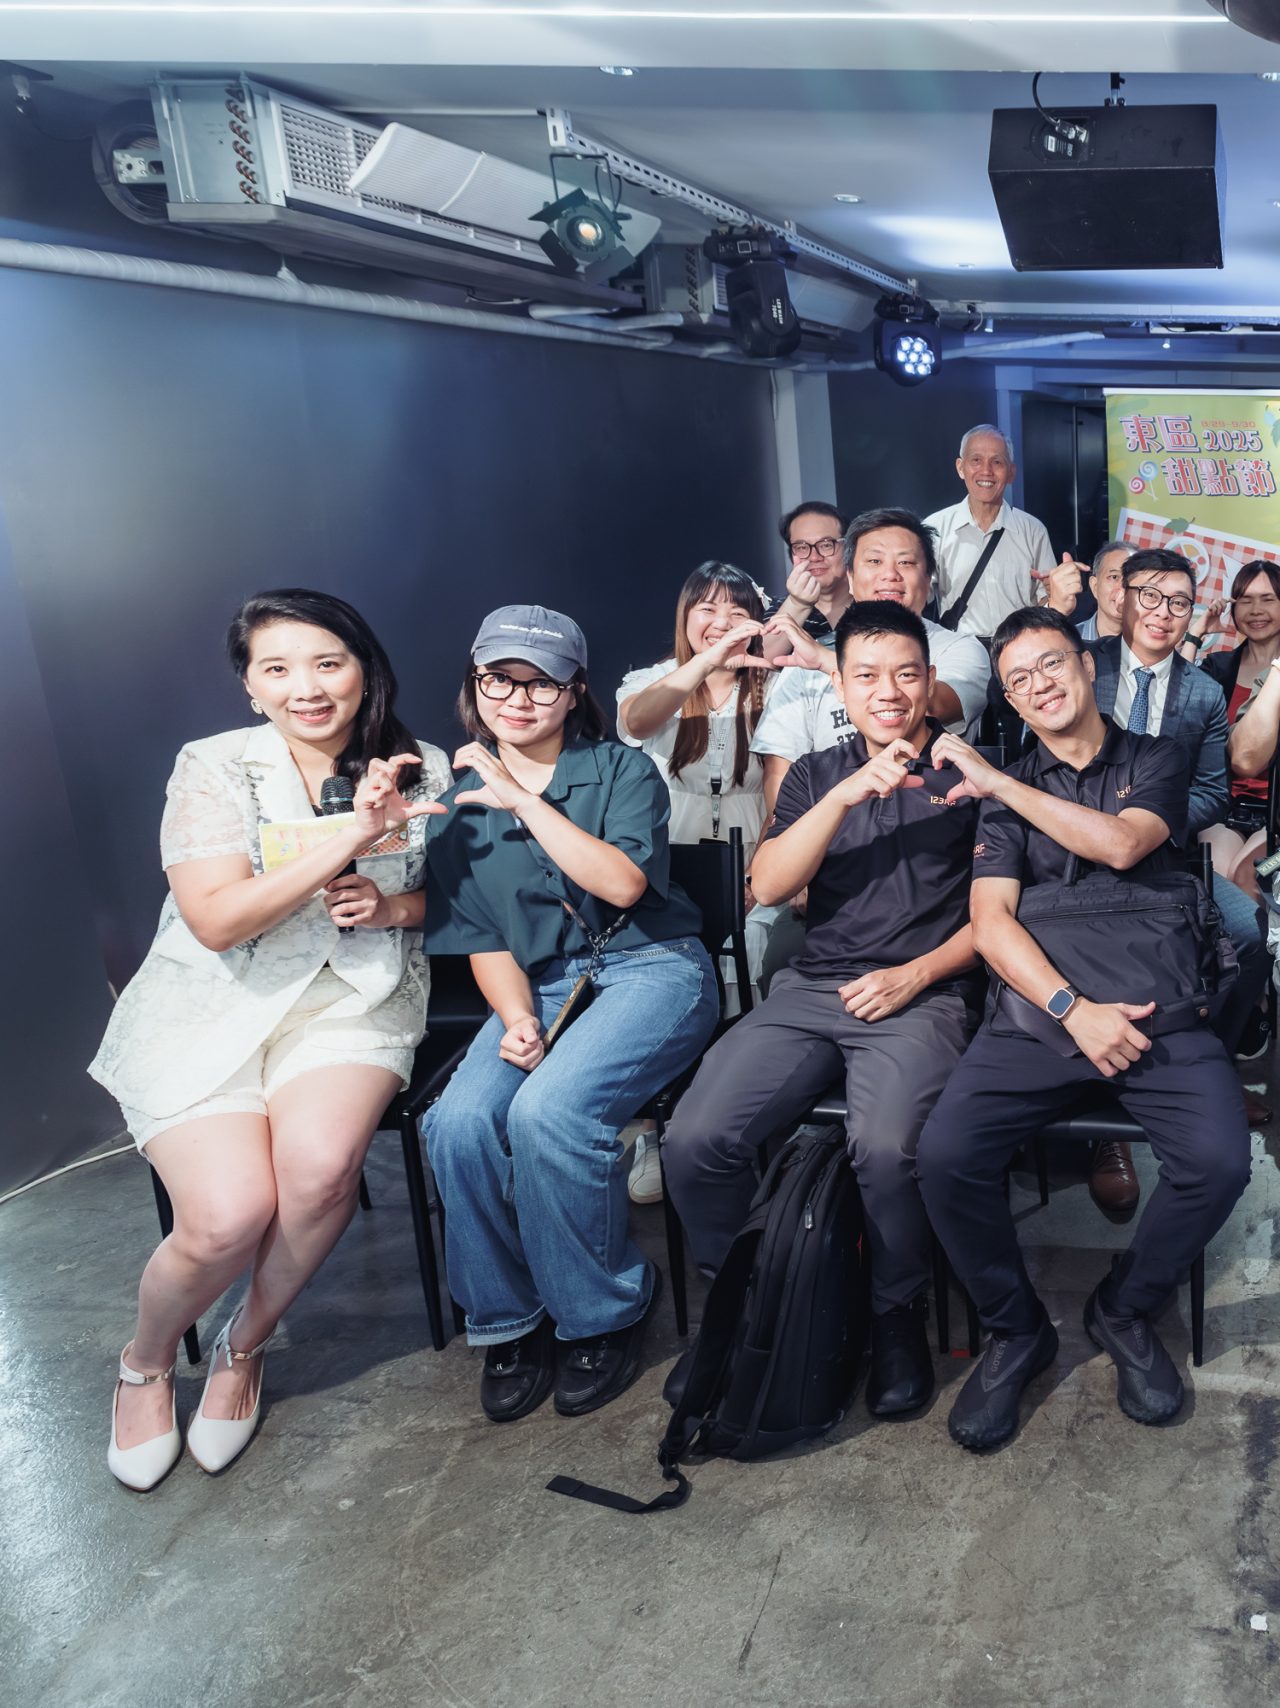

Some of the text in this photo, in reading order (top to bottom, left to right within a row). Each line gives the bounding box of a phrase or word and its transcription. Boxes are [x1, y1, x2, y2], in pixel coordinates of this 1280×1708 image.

[1119, 414, 1264, 453] 東區 2025
[1161, 457, 1278, 498] 甜點節
